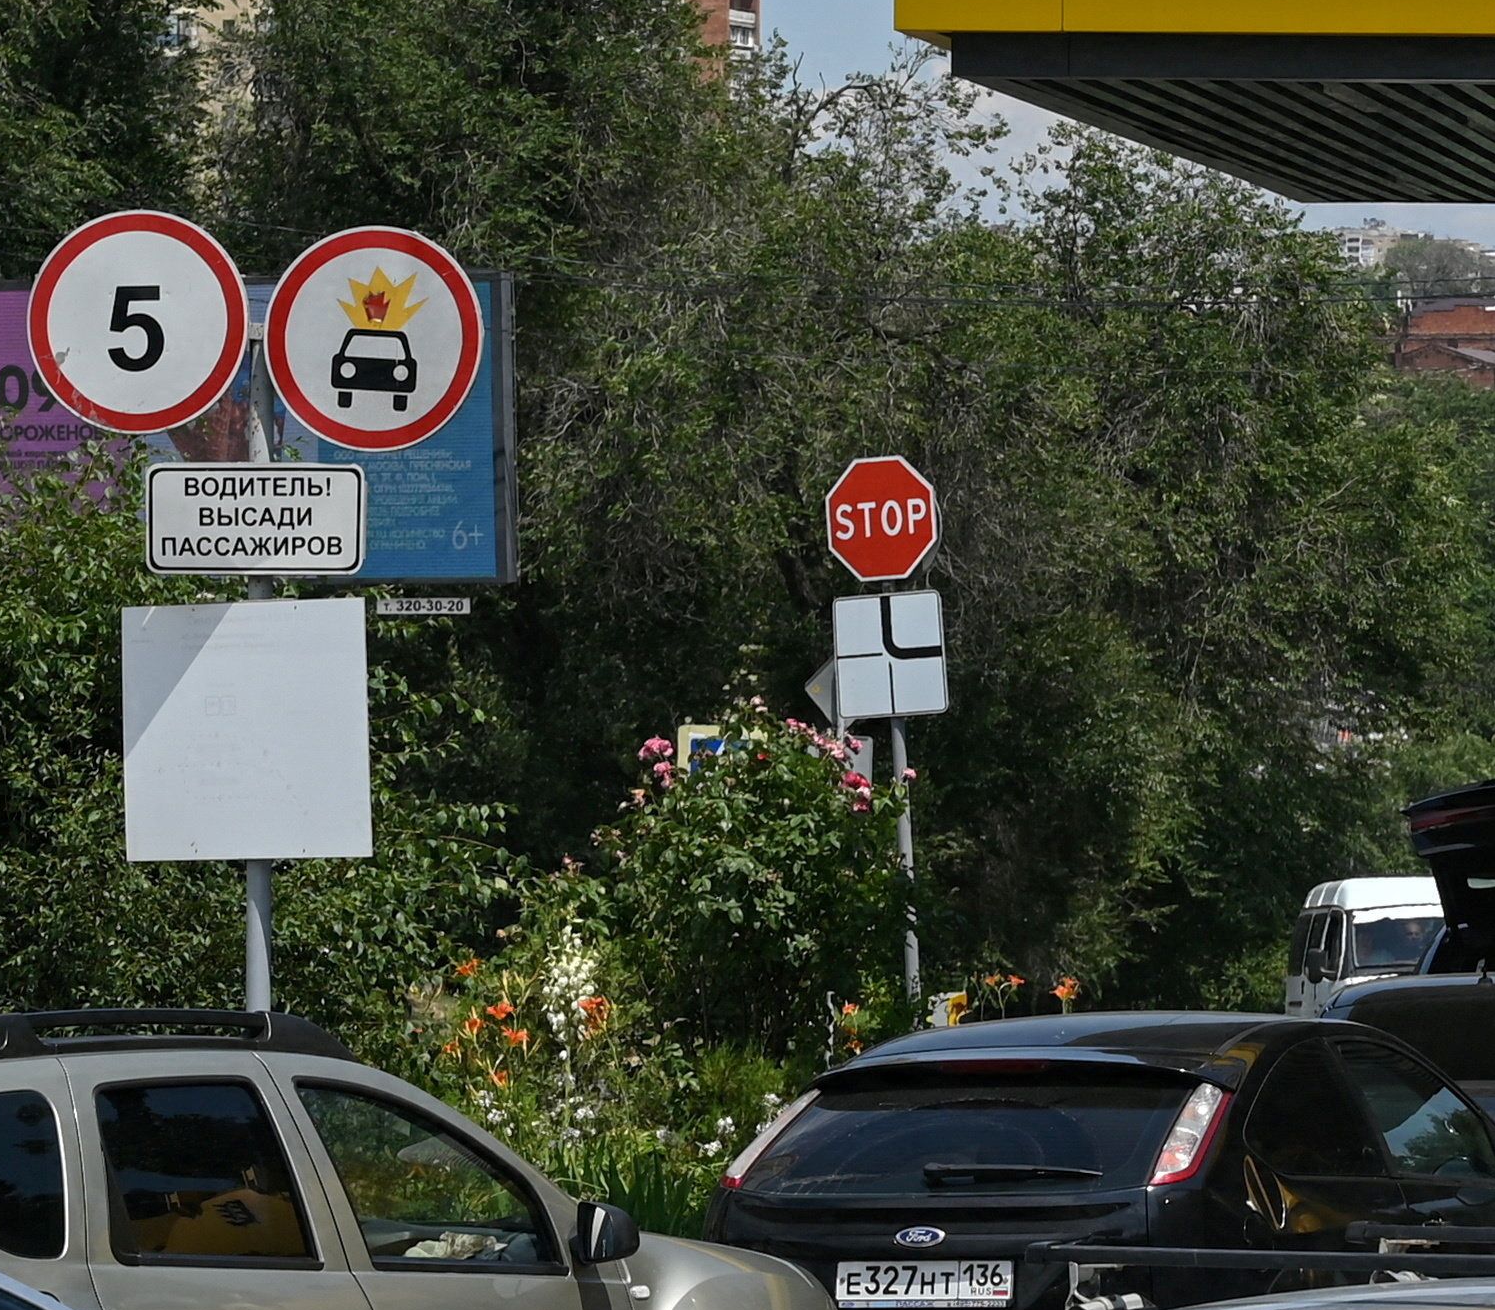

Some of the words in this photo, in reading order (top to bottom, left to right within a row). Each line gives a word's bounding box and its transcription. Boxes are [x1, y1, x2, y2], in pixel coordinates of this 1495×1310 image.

[106, 284, 166, 373] 5
[183, 476, 333, 500] ВОДИТЕЛЬ!
[198, 506, 314, 531] ВЫСАДИ
[835, 497, 927, 540] STOP
[452, 520, 485, 551] 6+
[160, 536, 344, 560] ПАССАЖИРОВ
[396, 599, 465, 613] 320-30-20
[905, 1229, 933, 1243] Ford
[846, 1264, 955, 1296] Е327НТ
[963, 1263, 1004, 1288] 136
[970, 1286, 993, 1296] RUS
